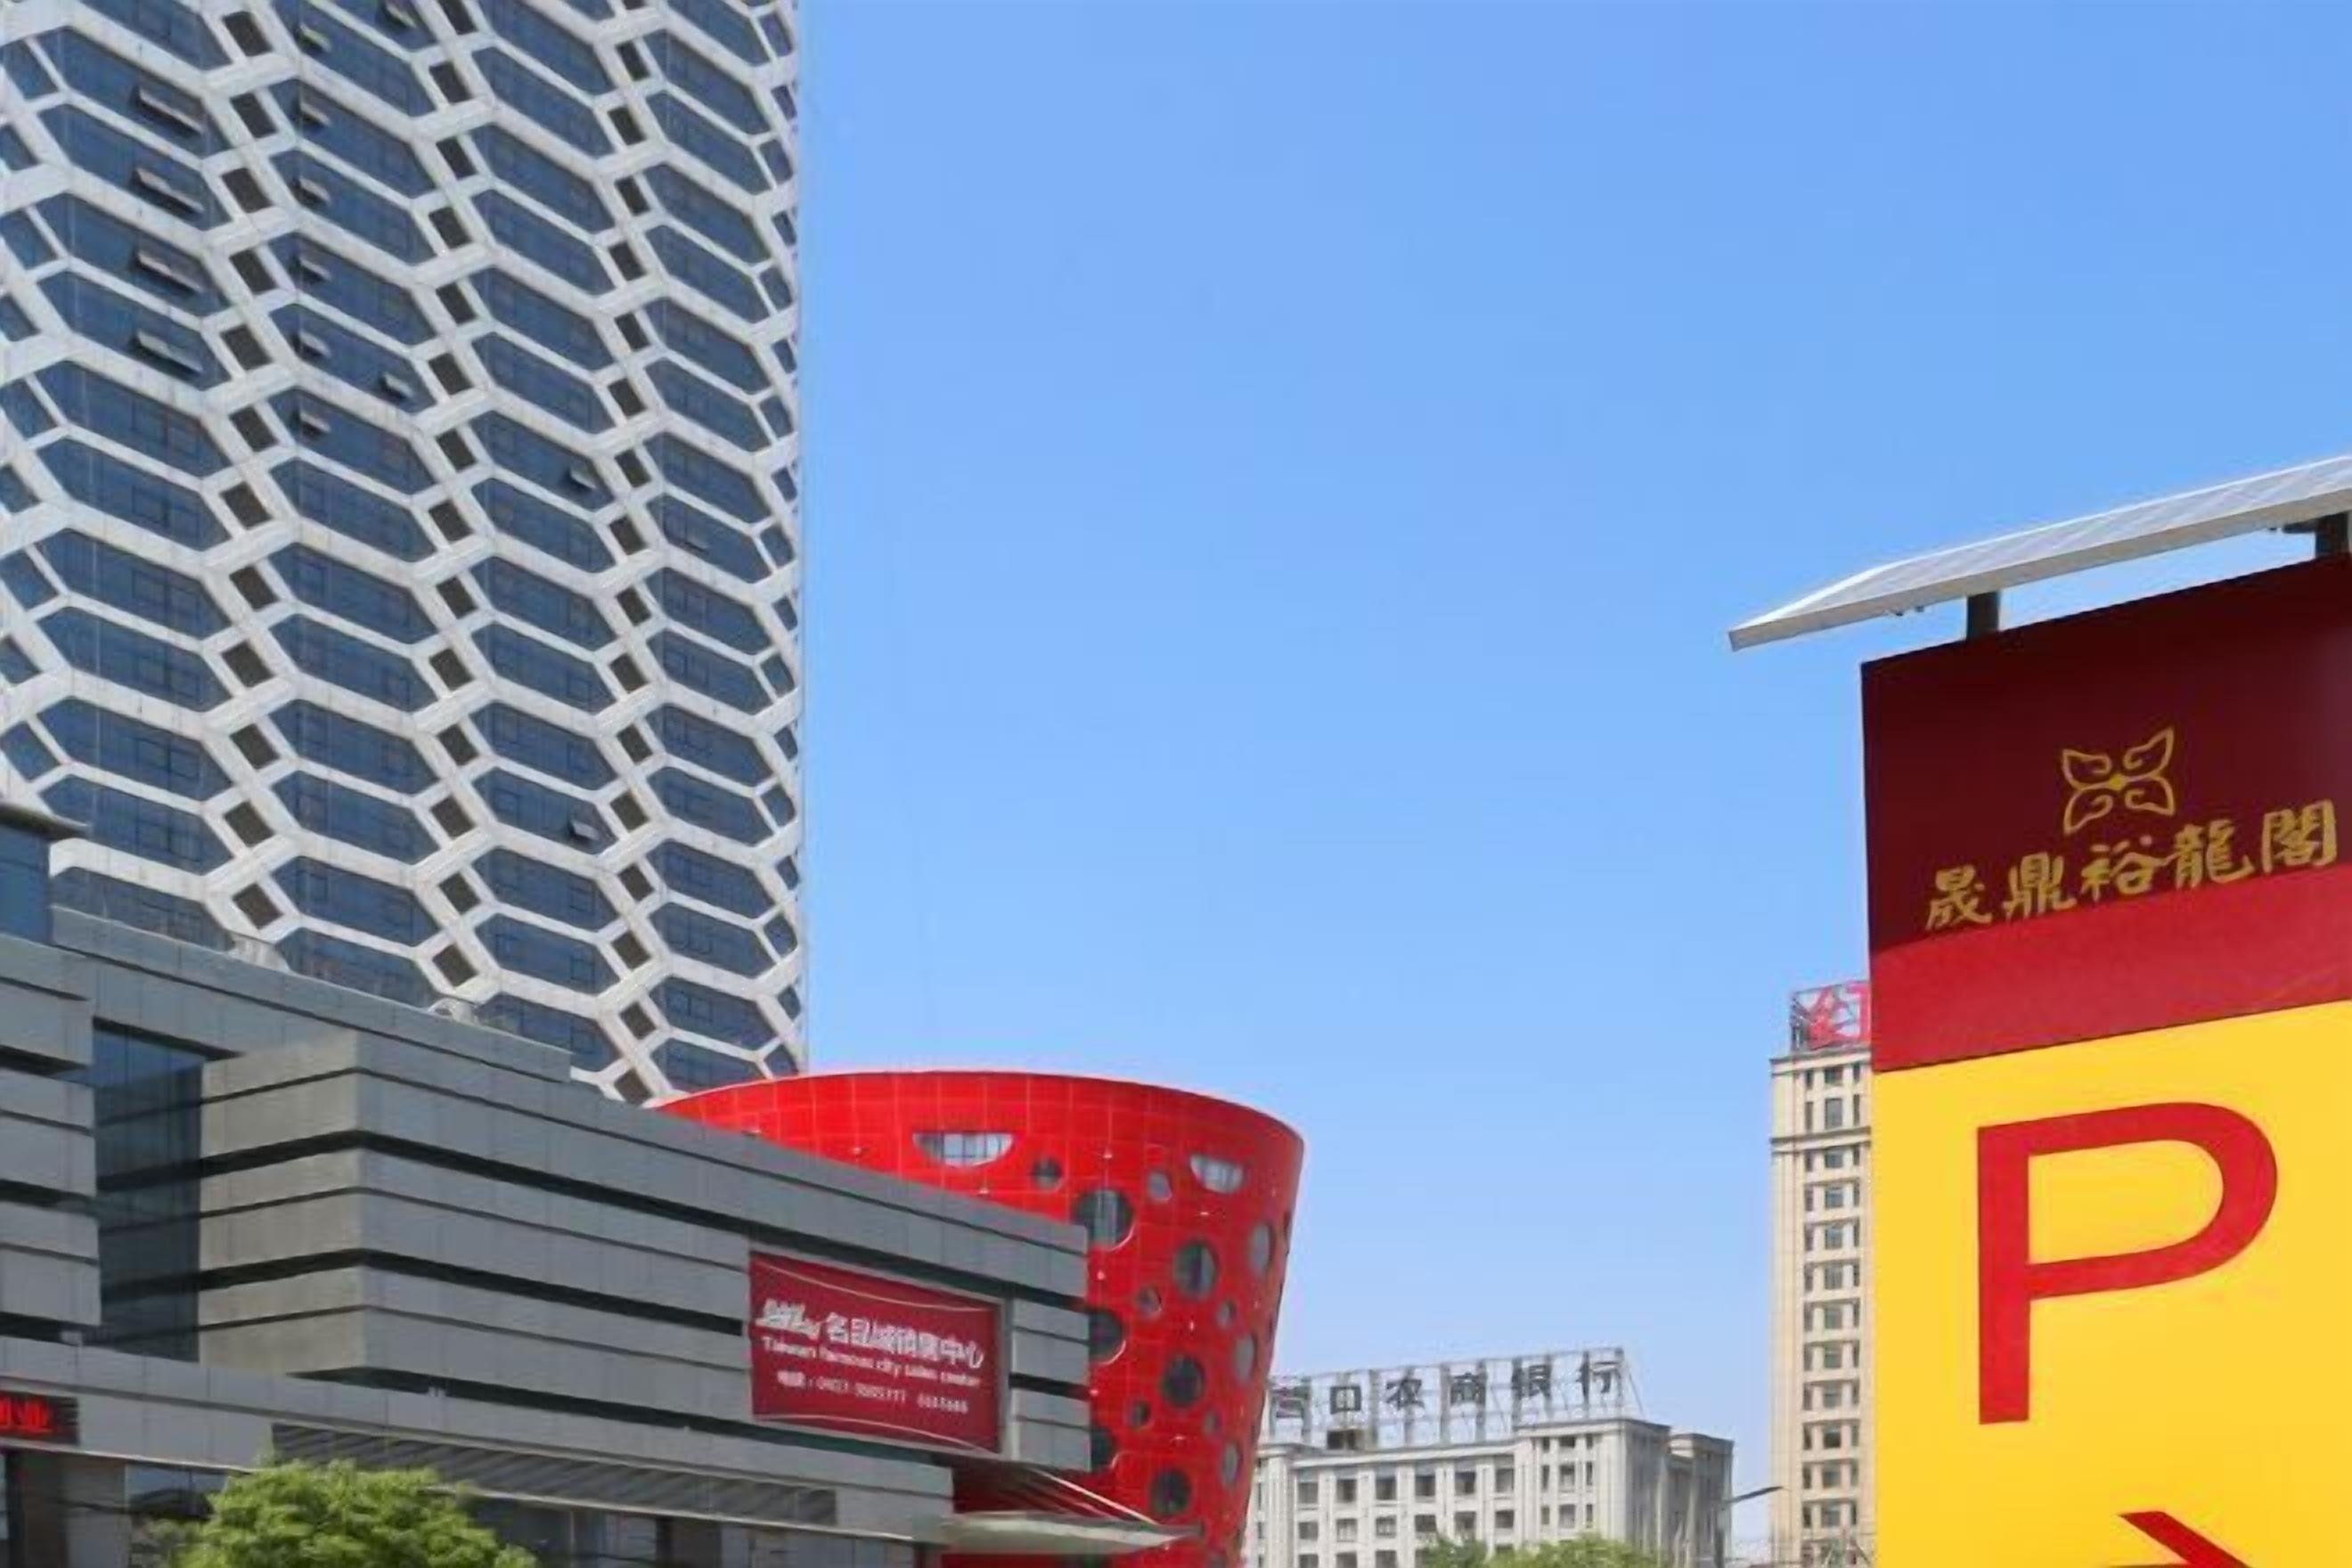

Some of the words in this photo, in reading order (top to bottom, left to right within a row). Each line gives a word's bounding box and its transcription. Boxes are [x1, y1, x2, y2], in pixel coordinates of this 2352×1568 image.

[1924, 798, 2339, 932] 晟鼎裕龍閣
[1976, 1101, 2278, 1425] P
